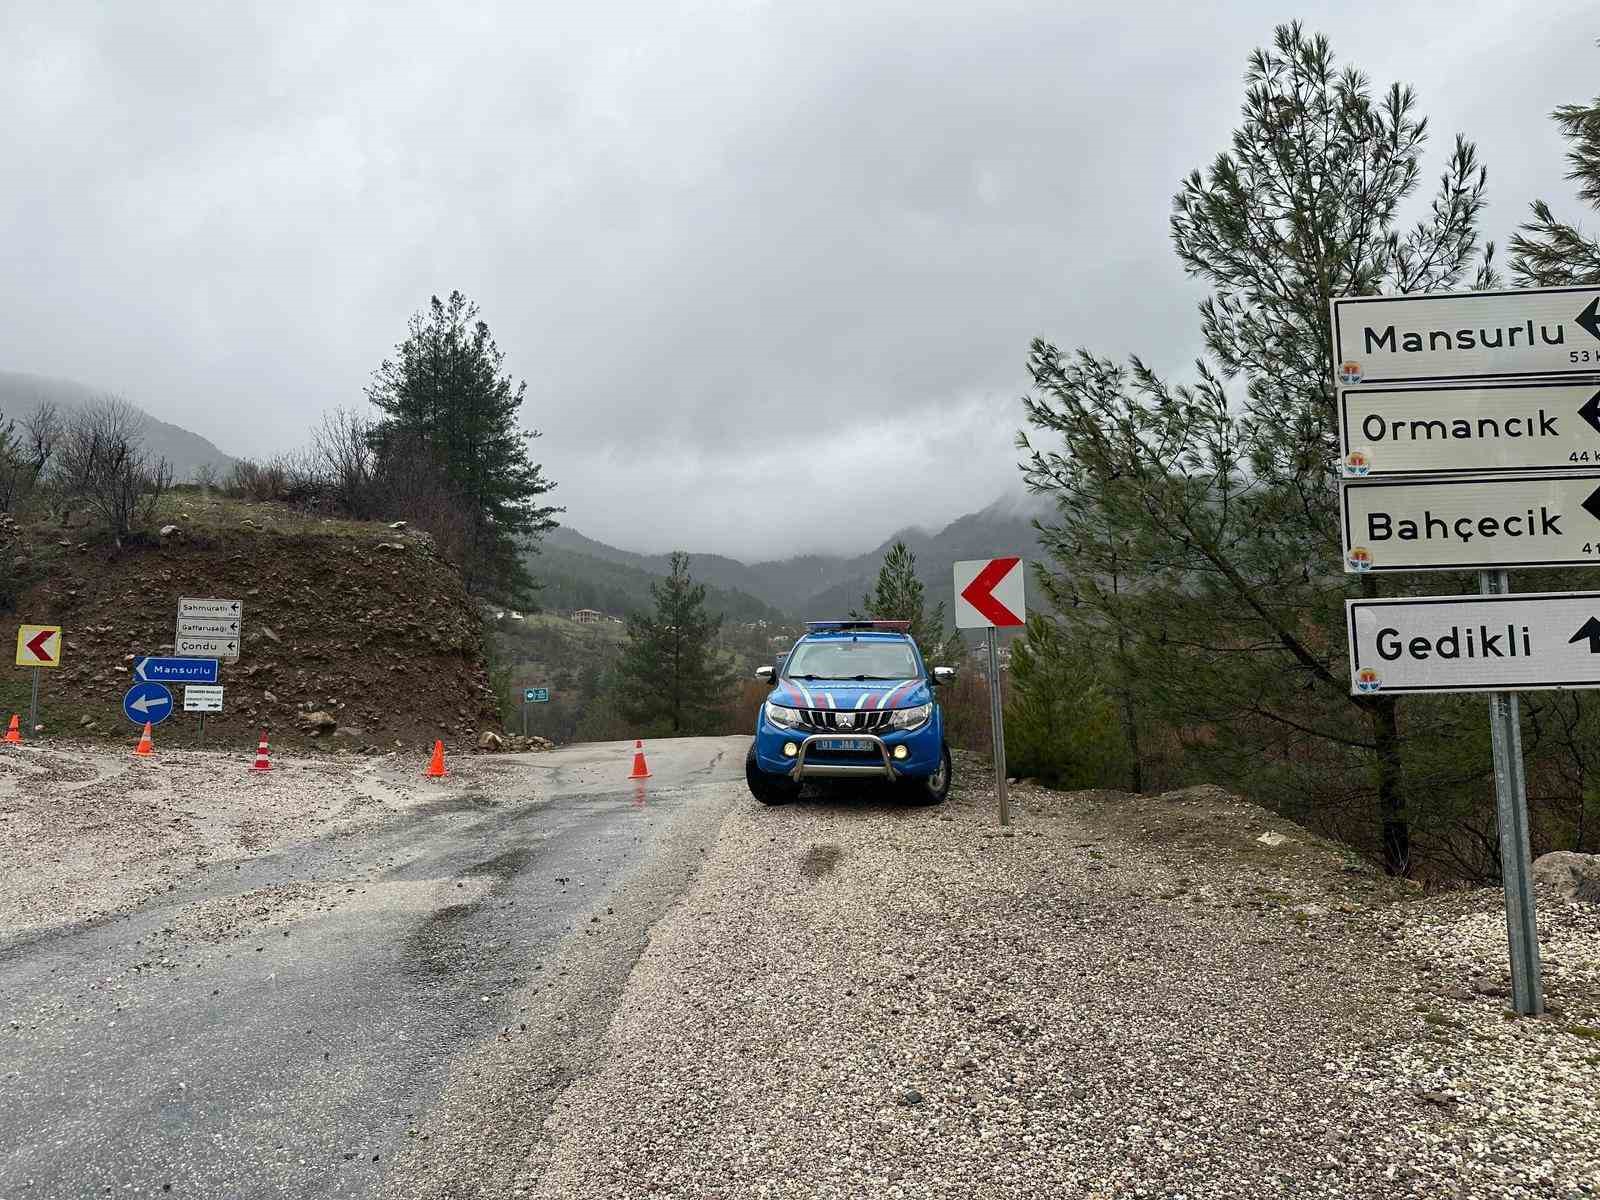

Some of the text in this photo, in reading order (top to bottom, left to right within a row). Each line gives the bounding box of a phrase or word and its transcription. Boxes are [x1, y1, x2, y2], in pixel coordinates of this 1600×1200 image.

[1363, 320, 1564, 355] Mansurlu
[1569, 351, 1590, 363] 53
[1362, 409, 1560, 442] Ormancık
[1569, 451, 1590, 463] 44
[1367, 507, 1563, 543] Bahçecik
[181, 641, 217, 651] Çondu
[1376, 624, 1531, 661] Gedikli
[154, 665, 210, 674] Mansurlu
